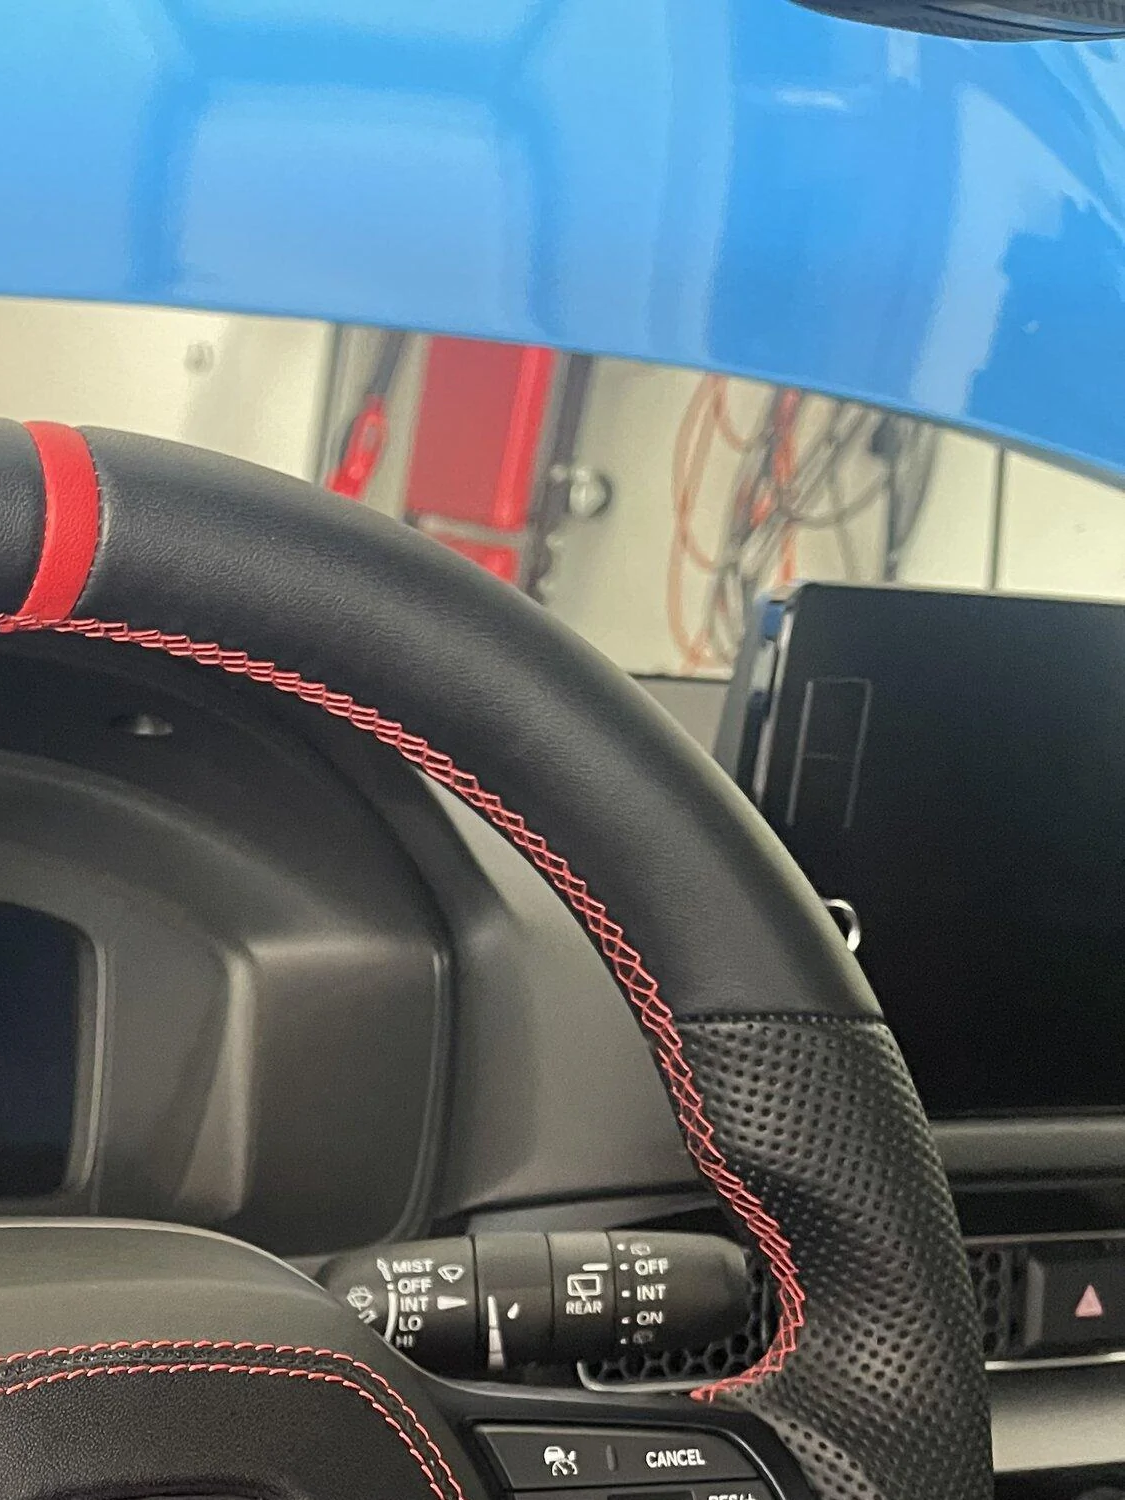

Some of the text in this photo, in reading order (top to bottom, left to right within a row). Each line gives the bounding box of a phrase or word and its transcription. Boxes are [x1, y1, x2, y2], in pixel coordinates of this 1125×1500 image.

[392, 1258, 433, 1273] MIST
[635, 1258, 668, 1276] OFF
[397, 1277, 433, 1295] OFF
[636, 1283, 667, 1301] INT
[399, 1295, 429, 1312] INT
[565, 1300, 603, 1315] REAR
[398, 1314, 423, 1331] LO
[636, 1310, 664, 1326] ON
[645, 1448, 706, 1468] CANCEL
